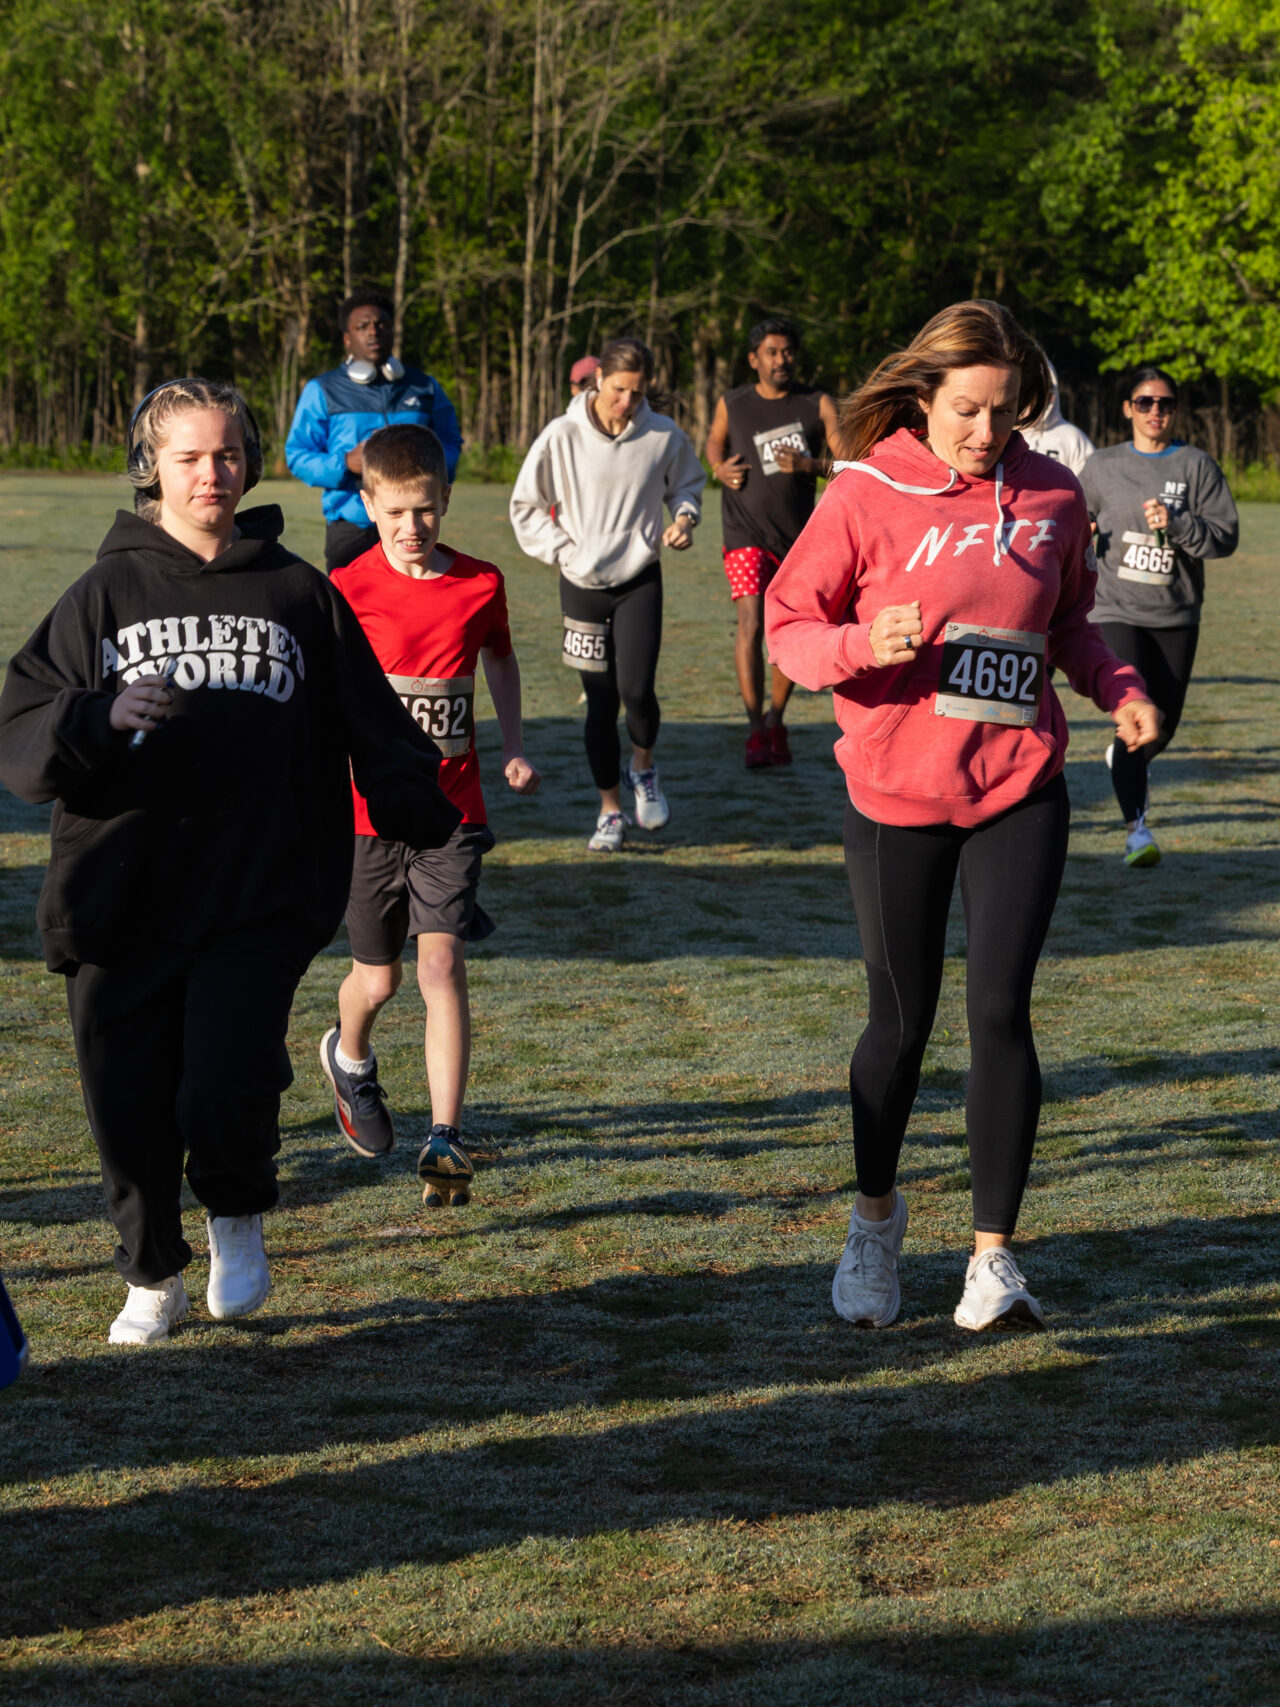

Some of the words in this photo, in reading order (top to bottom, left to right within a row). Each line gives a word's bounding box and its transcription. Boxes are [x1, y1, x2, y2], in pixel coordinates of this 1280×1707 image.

[1165, 481, 1187, 495] NF
[1122, 544, 1175, 574] 4665
[563, 630, 605, 660] 4655
[948, 648, 1038, 702] 4692
[400, 696, 467, 737] 632
